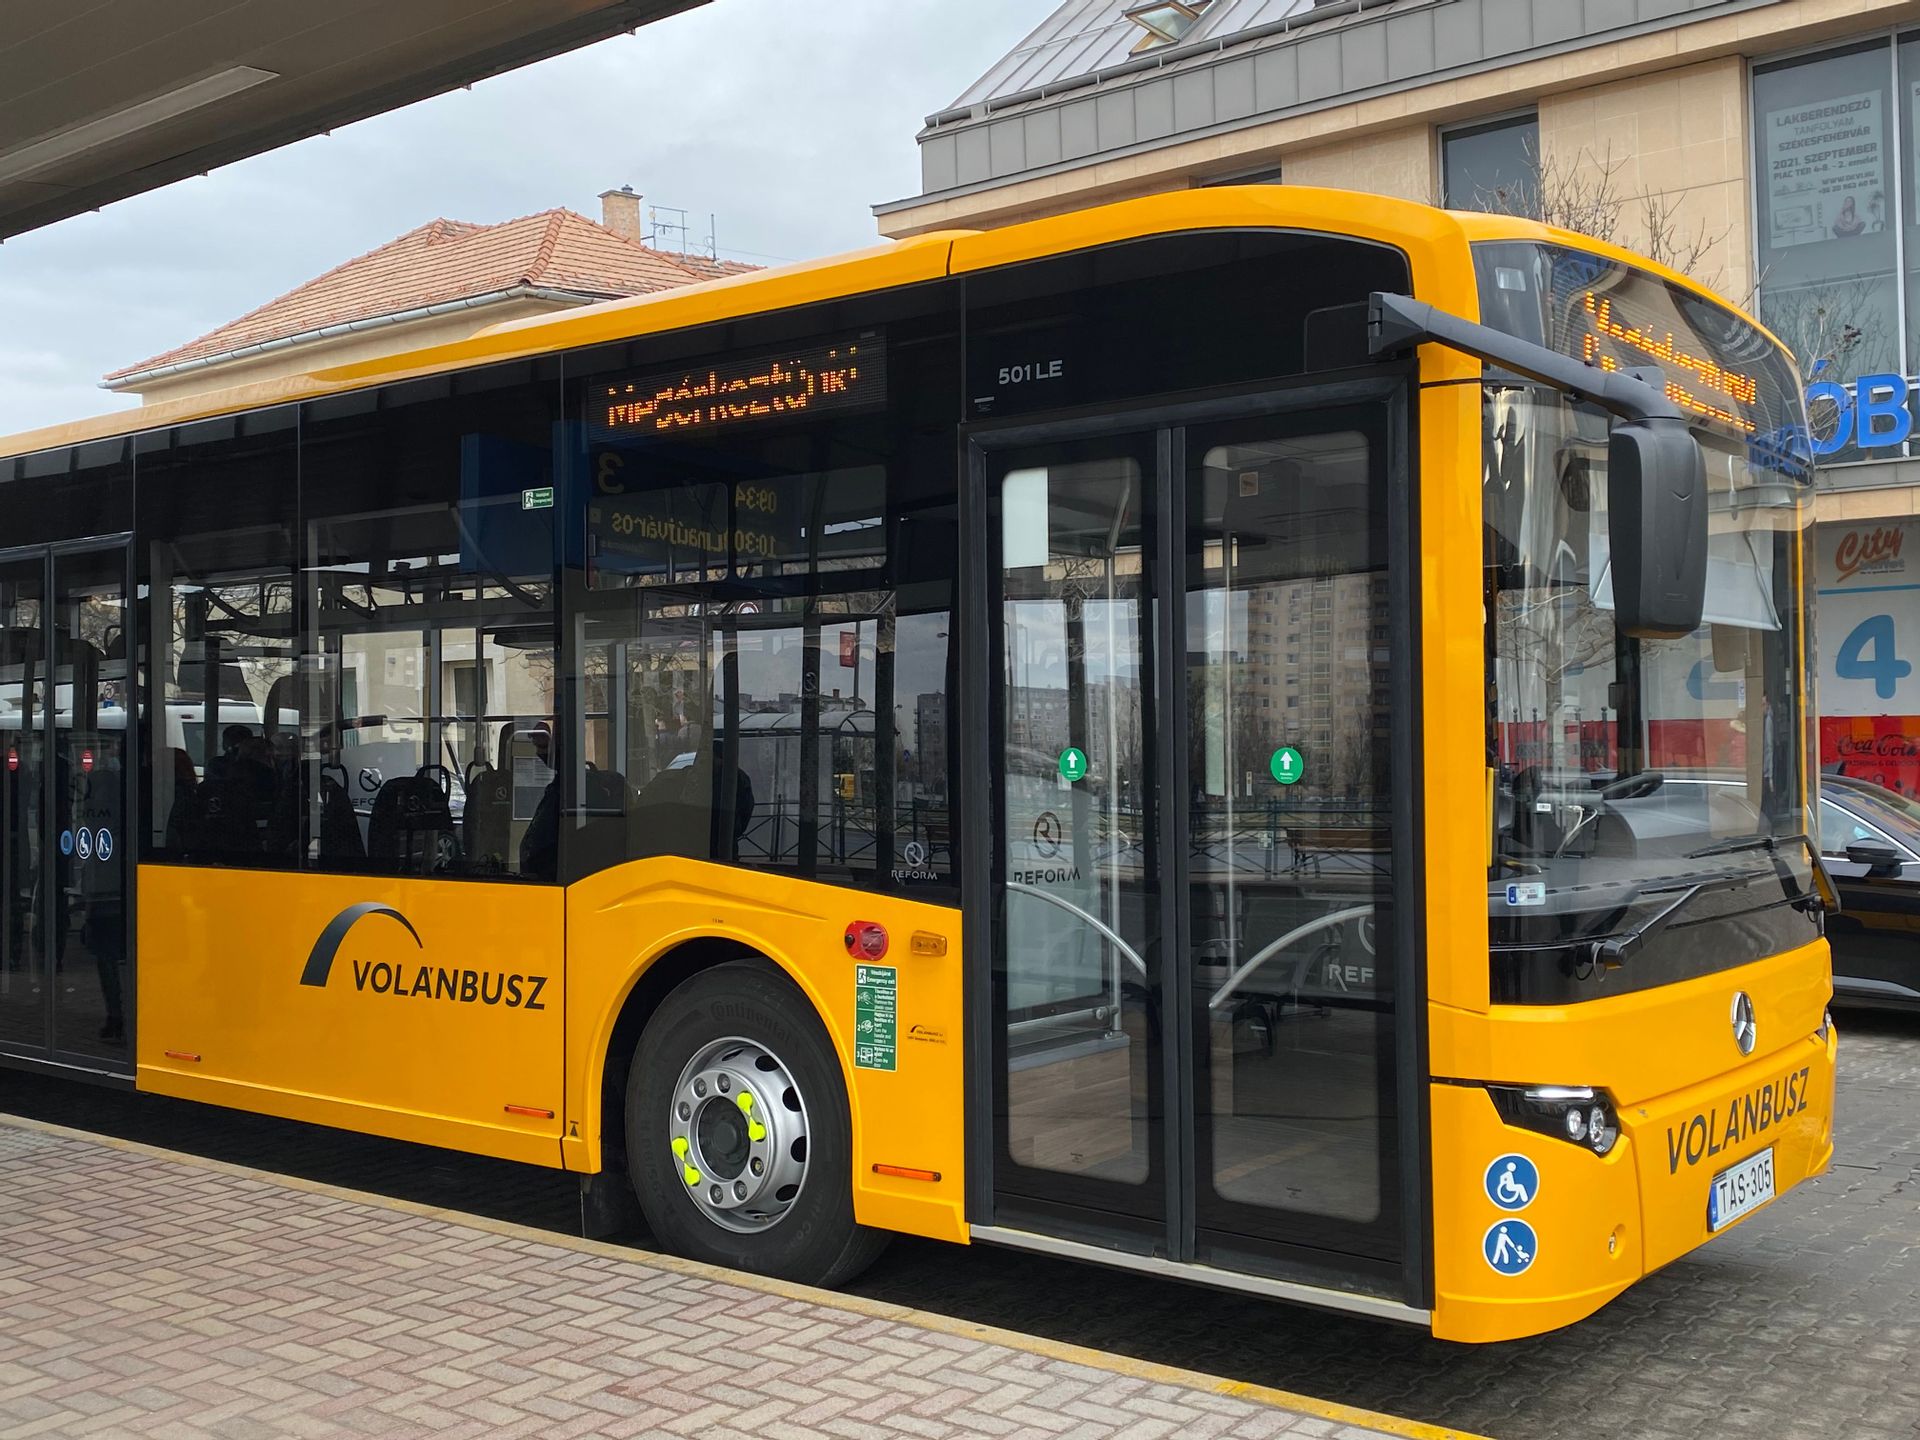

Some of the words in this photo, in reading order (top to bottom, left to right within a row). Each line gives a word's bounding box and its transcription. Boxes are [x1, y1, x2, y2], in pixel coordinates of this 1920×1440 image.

[1804, 142, 1877, 165] SZEPTEMBER
[998, 364, 1031, 385] 501
[1036, 360, 1063, 379] LE
[1836, 527, 1905, 575] City
[1836, 614, 1912, 700] 4
[891, 869, 938, 883] REFORM
[1014, 867, 1082, 886] REFORM
[353, 960, 548, 1010] VOLÁNBUSZ
[1667, 1067, 1810, 1175] VOLÁNBUSZ
[1719, 1159, 1772, 1214] TAS-305
